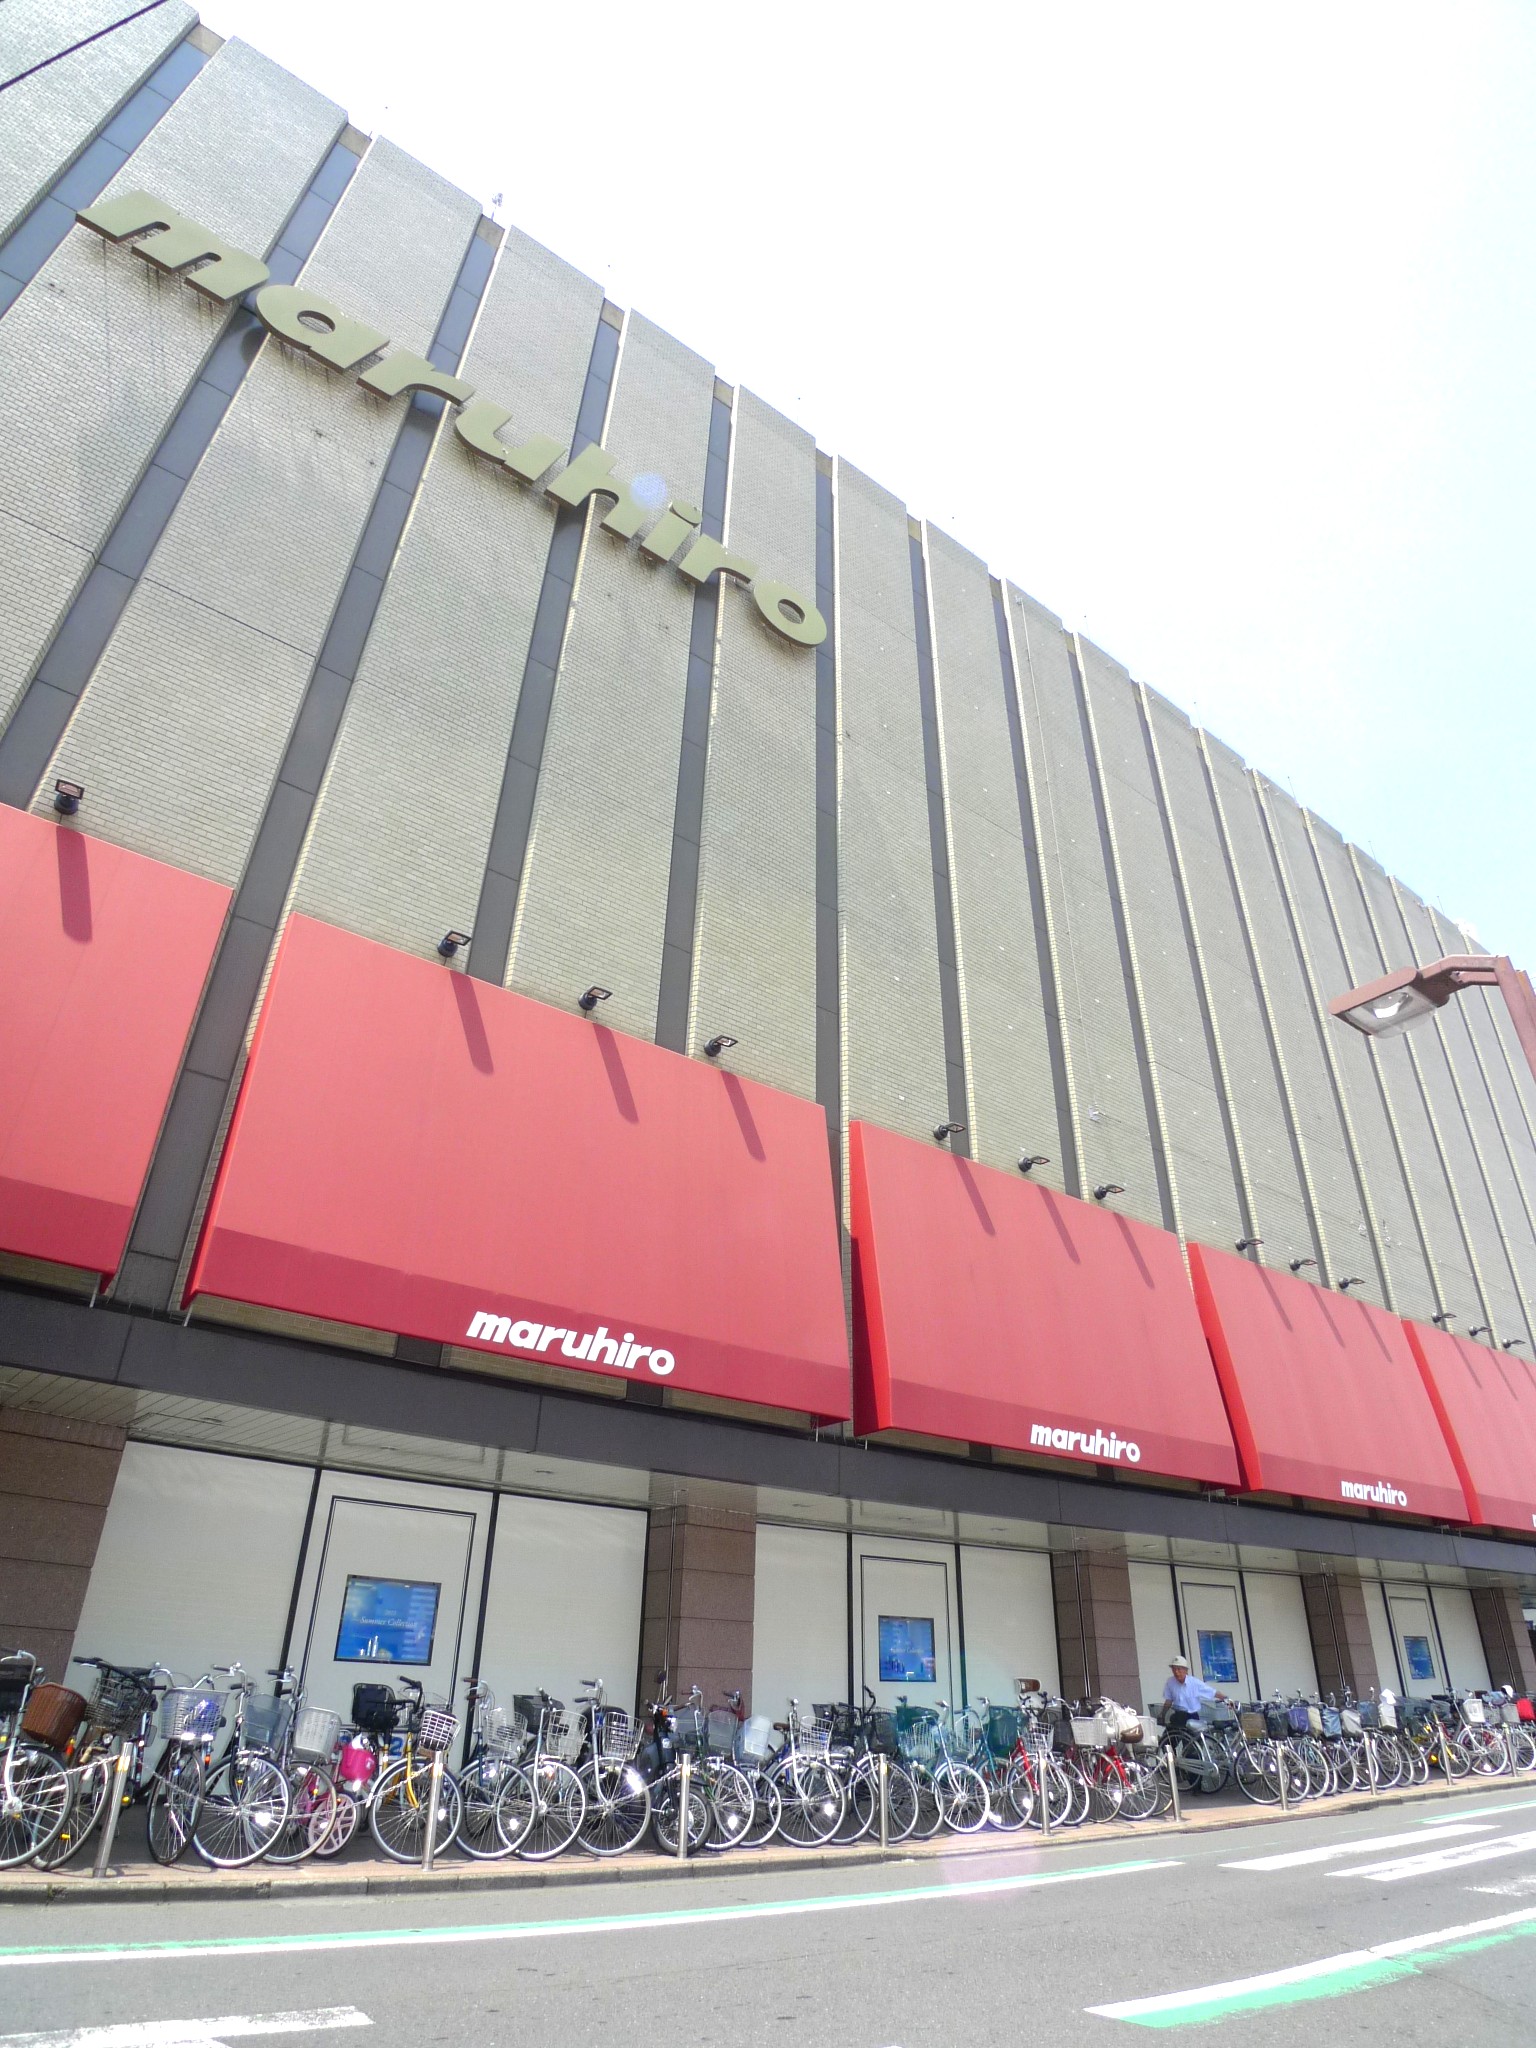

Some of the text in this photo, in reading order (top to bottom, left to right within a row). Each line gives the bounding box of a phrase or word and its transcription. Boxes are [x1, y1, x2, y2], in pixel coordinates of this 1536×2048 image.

[76, 190, 828, 648] maruhiro
[466, 1311, 675, 1375] maruhiro
[1030, 1424, 1140, 1462] maruhiro
[1341, 1480, 1407, 1506] maruhiro
